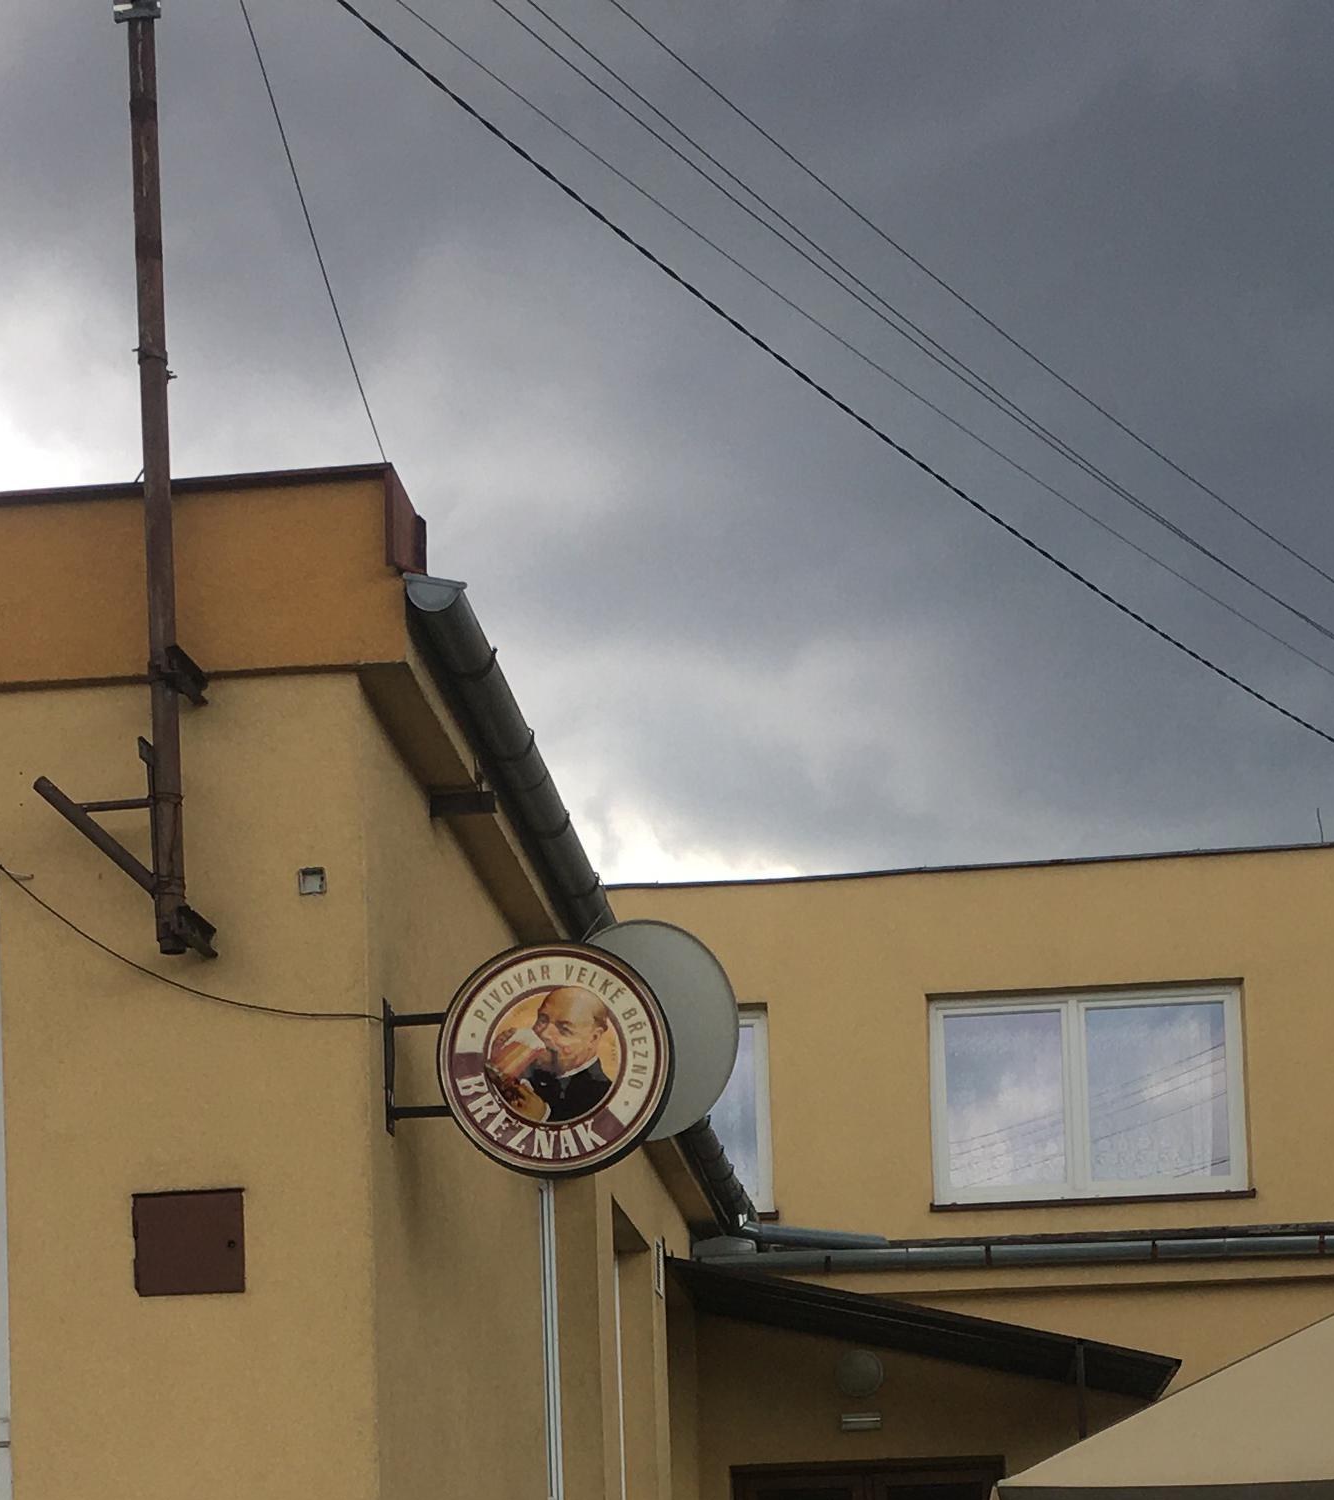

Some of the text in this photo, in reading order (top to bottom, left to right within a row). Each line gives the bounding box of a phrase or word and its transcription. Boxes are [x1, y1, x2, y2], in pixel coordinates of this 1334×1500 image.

[473, 964, 551, 1023] PIVOVAR
[564, 964, 627, 1005] VELKÉ
[621, 1007, 650, 1090] BŘEZNO
[455, 1072, 609, 1160] BŘEZŇÁK
